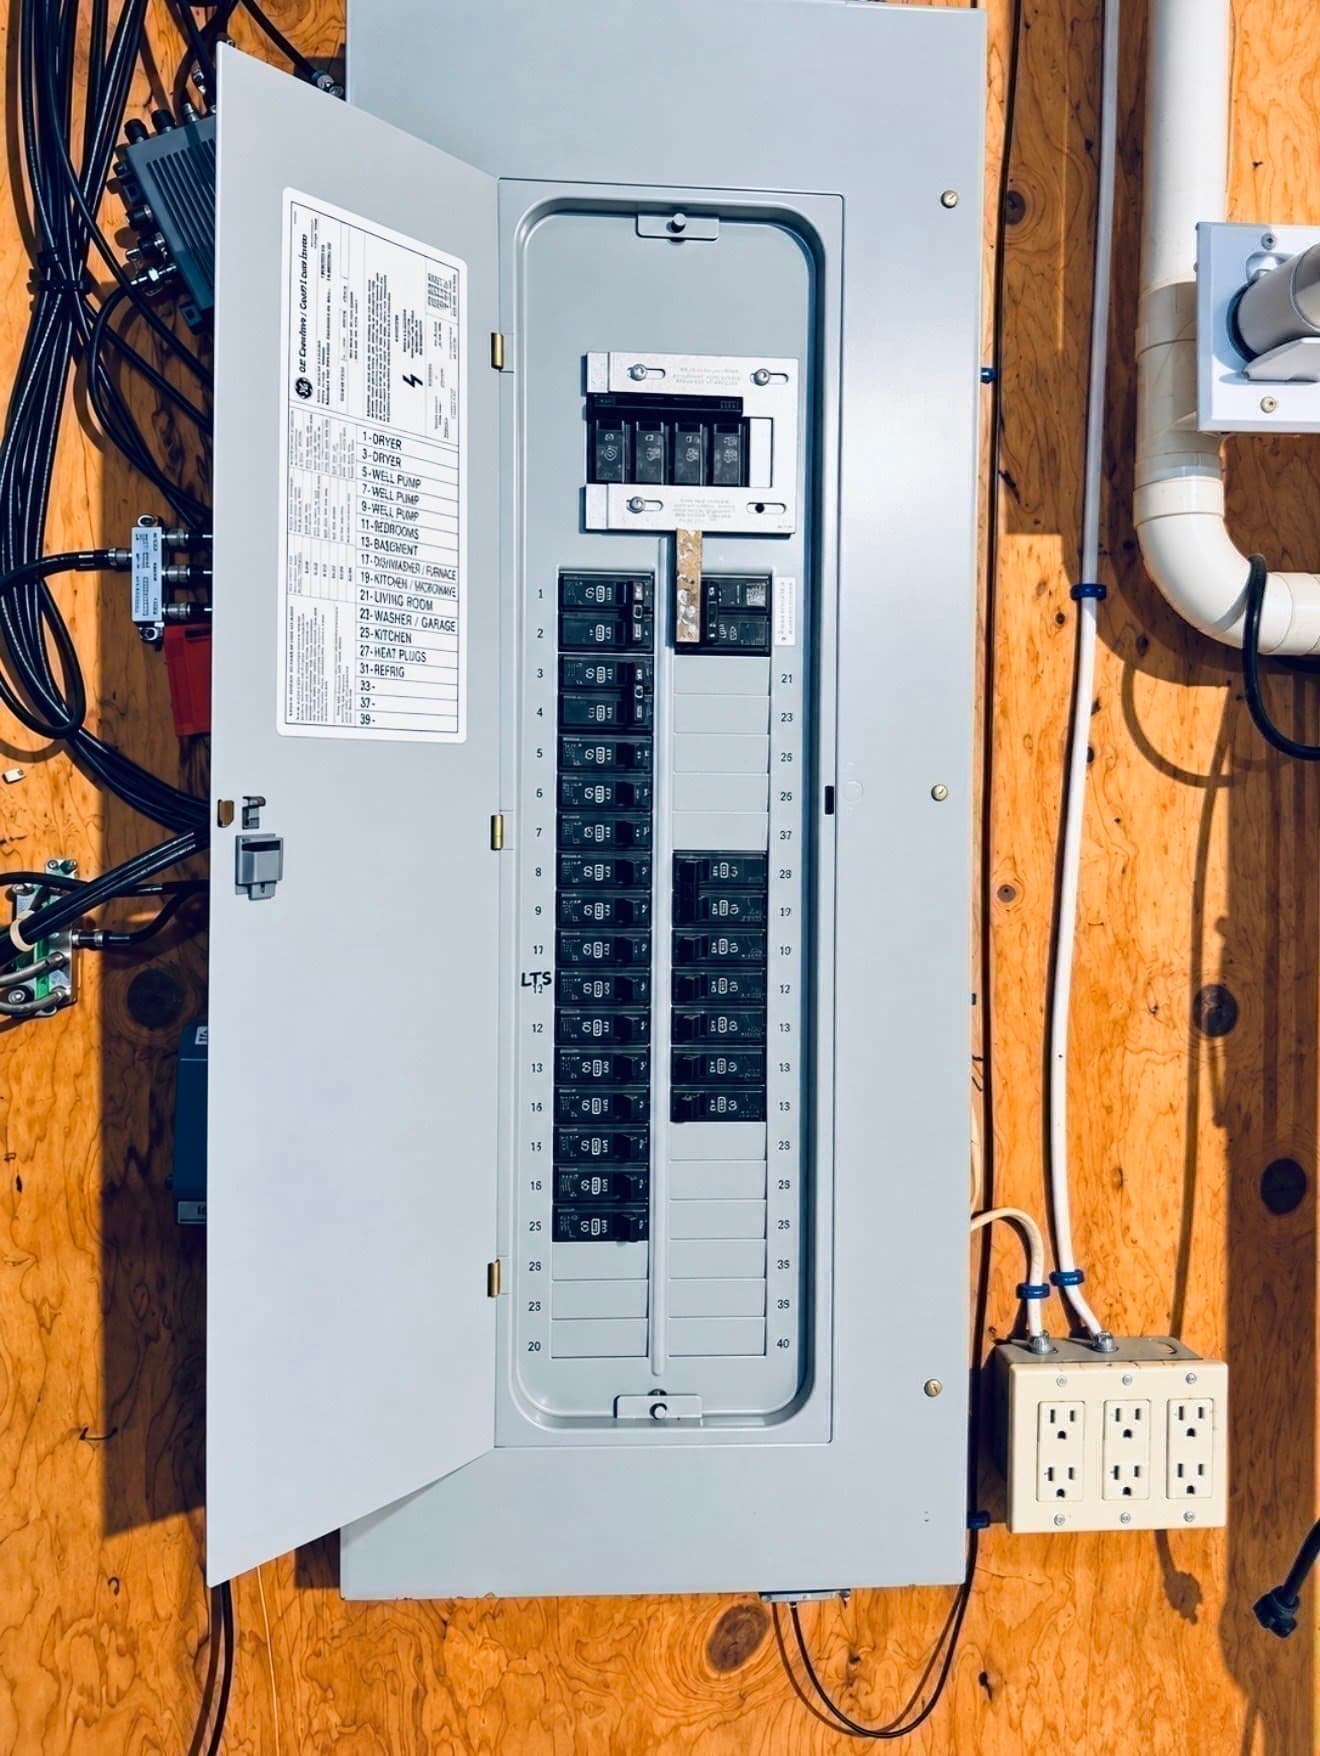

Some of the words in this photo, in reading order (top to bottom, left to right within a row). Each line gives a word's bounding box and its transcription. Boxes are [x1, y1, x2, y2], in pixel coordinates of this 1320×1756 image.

[397, 474, 421, 489] PUMP
[396, 491, 419, 506] PUMP
[538, 588, 543, 599] 1
[406, 596, 433, 611] ROOM
[421, 616, 456, 632] GARAGE
[536, 628, 544, 639] 2
[398, 648, 427, 663] PLUGS
[536, 667, 544, 679] 3
[781, 673, 793, 684] 21
[536, 707, 543, 717] 4
[780, 712, 794, 723] 23
[536, 747, 543, 759] 5
[536, 788, 544, 799] 6
[535, 827, 543, 838] 7
[779, 830, 793, 841] 37
[535, 866, 542, 878] 8
[534, 905, 542, 916] 9
[521, 971, 552, 987] LTS
[779, 984, 791, 994] 12
[532, 1023, 544, 1033] 12
[779, 1022, 791, 1033] 13
[531, 1062, 543, 1073] 13
[778, 1062, 791, 1073] 13
[527, 1340, 541, 1352] 20
[776, 1338, 790, 1349] 40
